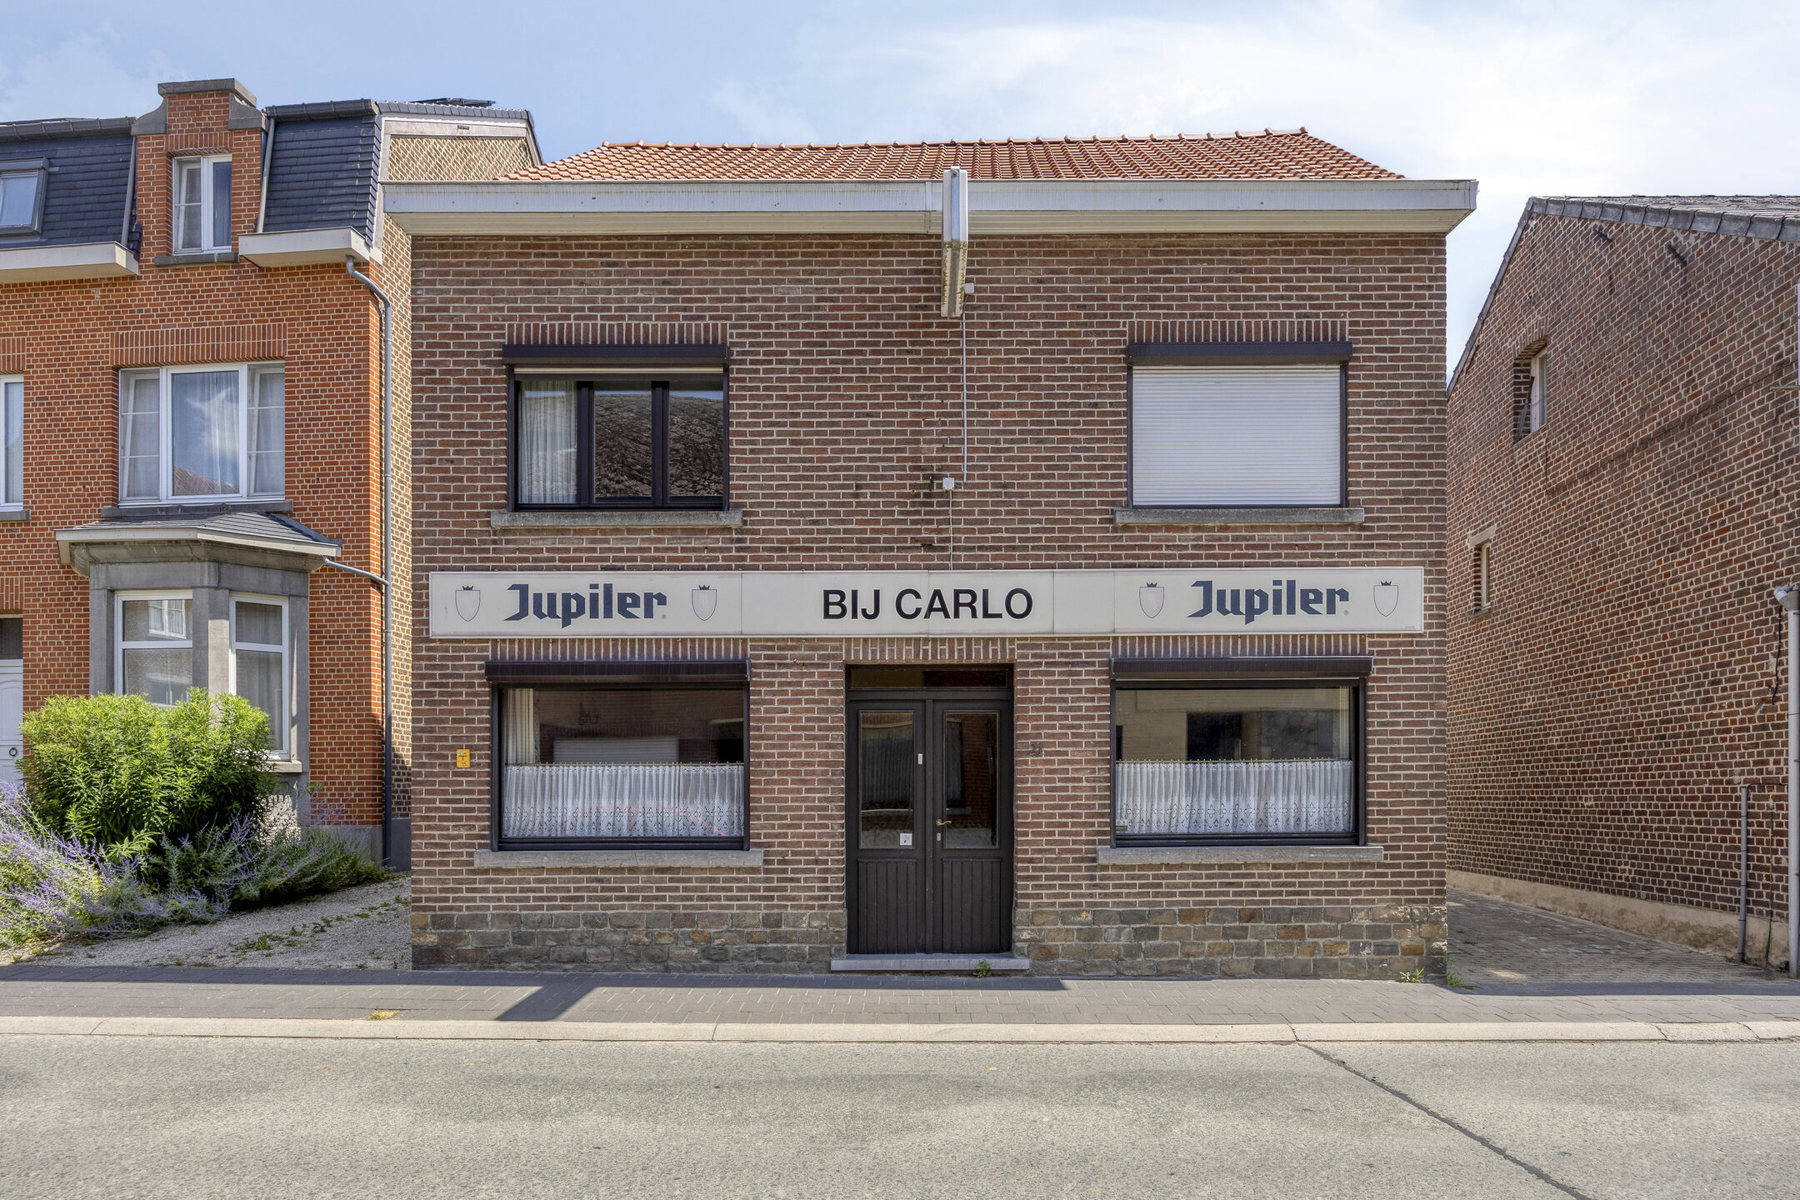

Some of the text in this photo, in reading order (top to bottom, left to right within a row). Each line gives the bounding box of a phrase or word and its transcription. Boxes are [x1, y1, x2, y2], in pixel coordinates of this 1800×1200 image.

[503, 583, 667, 629] Jupiler
[823, 588, 1033, 620] BIJ CARLO
[1187, 579, 1350, 625] Jupiler
